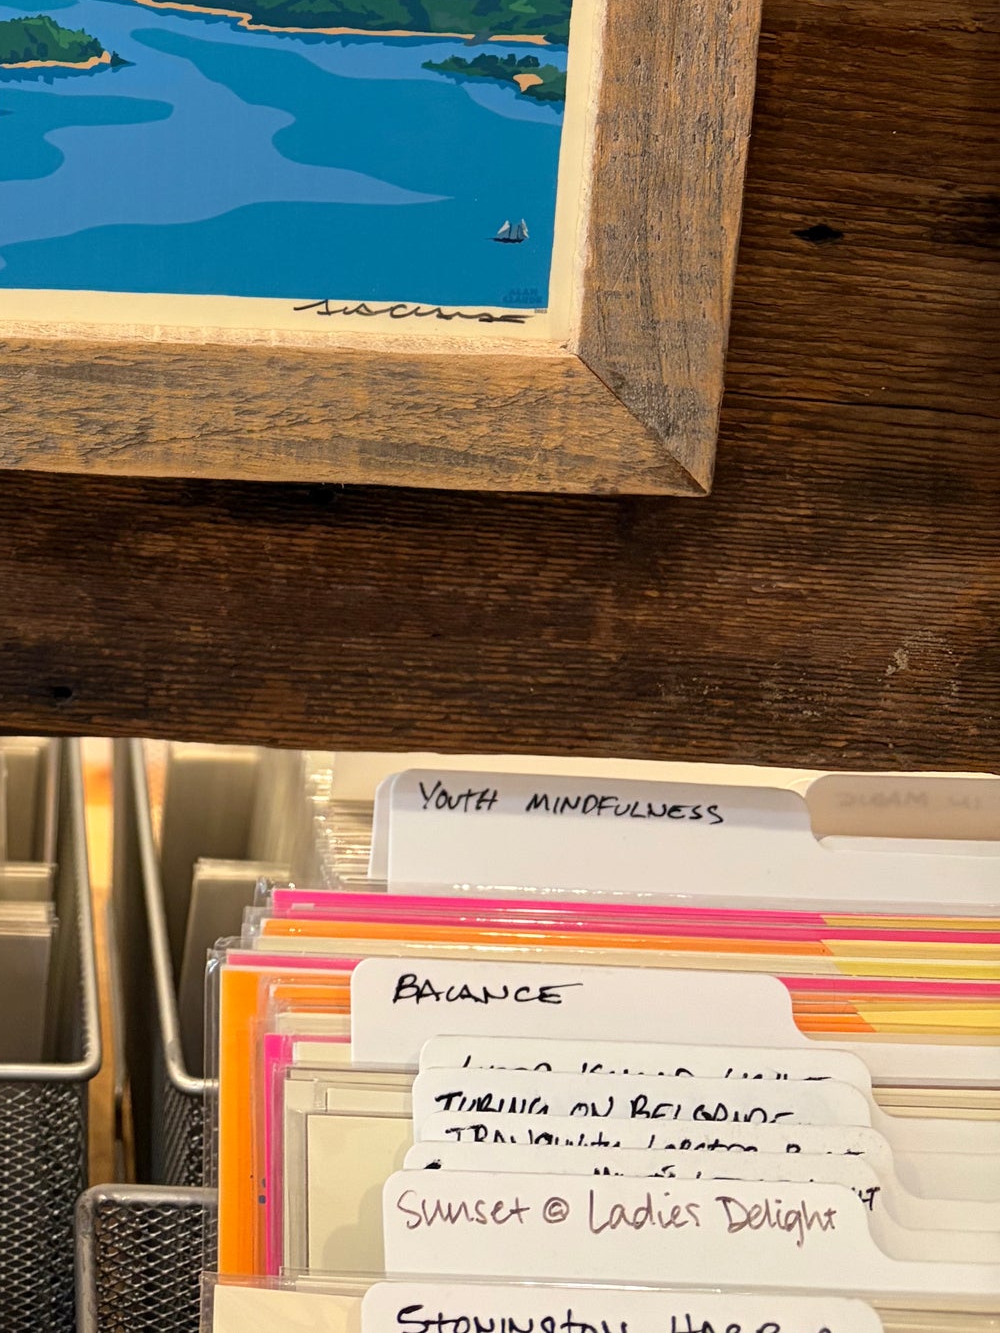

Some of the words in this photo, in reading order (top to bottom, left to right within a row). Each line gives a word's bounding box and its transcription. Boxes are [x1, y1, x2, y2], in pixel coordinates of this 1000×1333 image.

[419, 781, 498, 812] YOUTH
[525, 793, 724, 825] MINDFULNESS
[392, 973, 583, 1004] BALANCE
[397, 1190, 530, 1229] Sunset
[589, 1189, 700, 1234] Ladies
[715, 1190, 837, 1247] Delight
